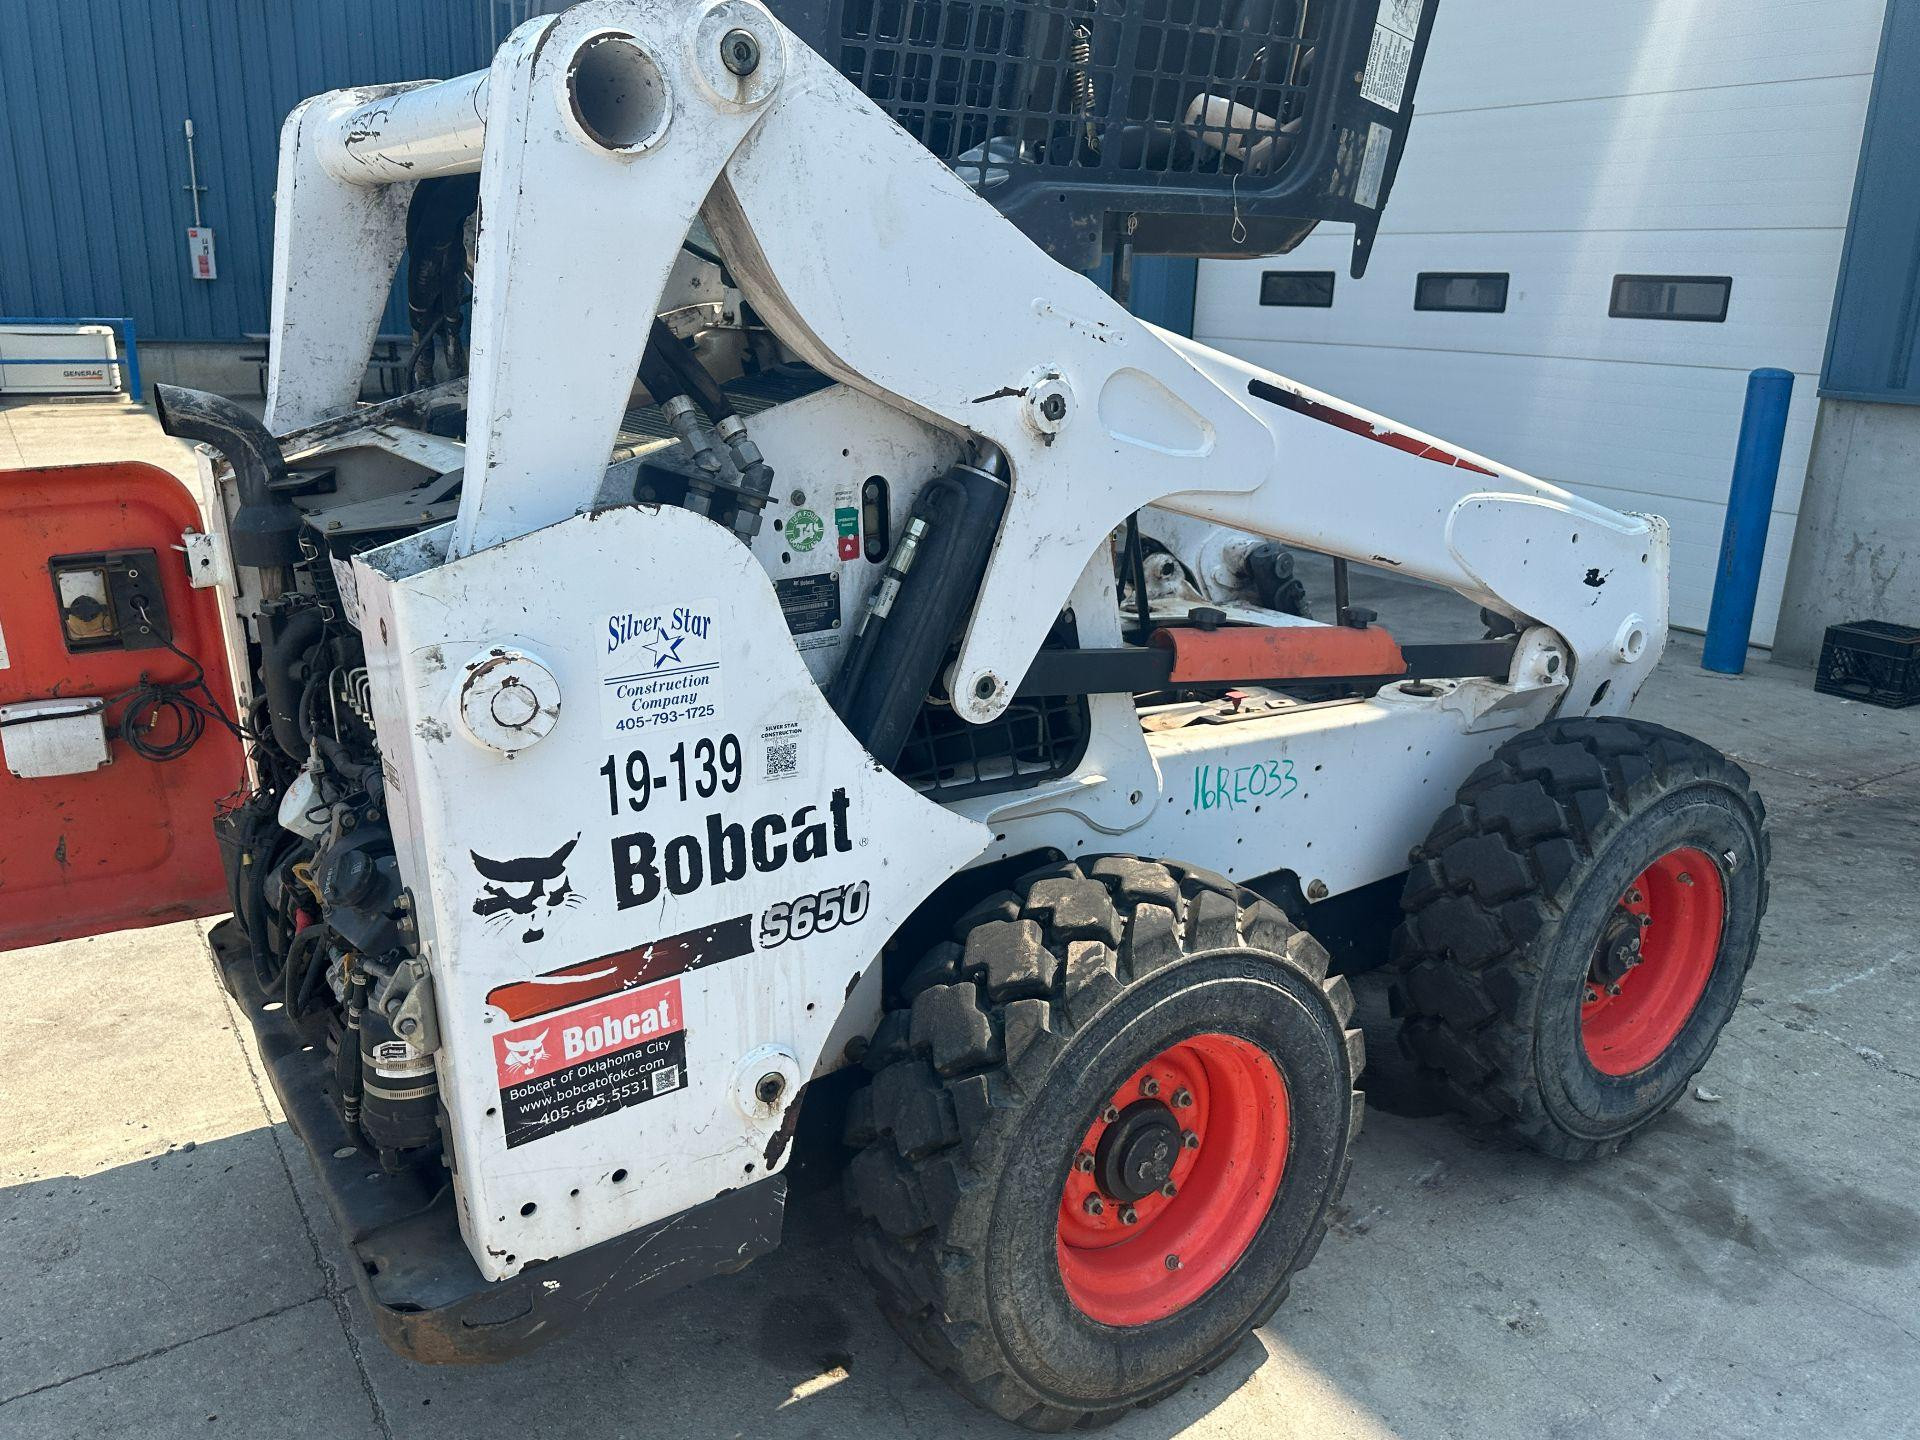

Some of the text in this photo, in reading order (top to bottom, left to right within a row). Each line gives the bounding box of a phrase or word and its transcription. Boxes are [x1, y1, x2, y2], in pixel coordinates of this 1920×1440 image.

[803, 510, 819, 522] FOUR
[608, 607, 711, 654] Silver Star
[617, 674, 710, 698] Construction
[632, 692, 698, 712] Company
[616, 704, 715, 731] 405-793-1725
[760, 728, 802, 738] CONSTRUCTION
[600, 734, 742, 816] 19-139
[1192, 759, 1298, 811] 16RE033
[611, 788, 852, 910] Bobcat
[760, 880, 870, 949] S650
[562, 1000, 670, 1060] Bobcat
[510, 1040, 671, 1100] Bobcat of Oklahoma City
[520, 1058, 665, 1114] www.bobcatofokc.com
